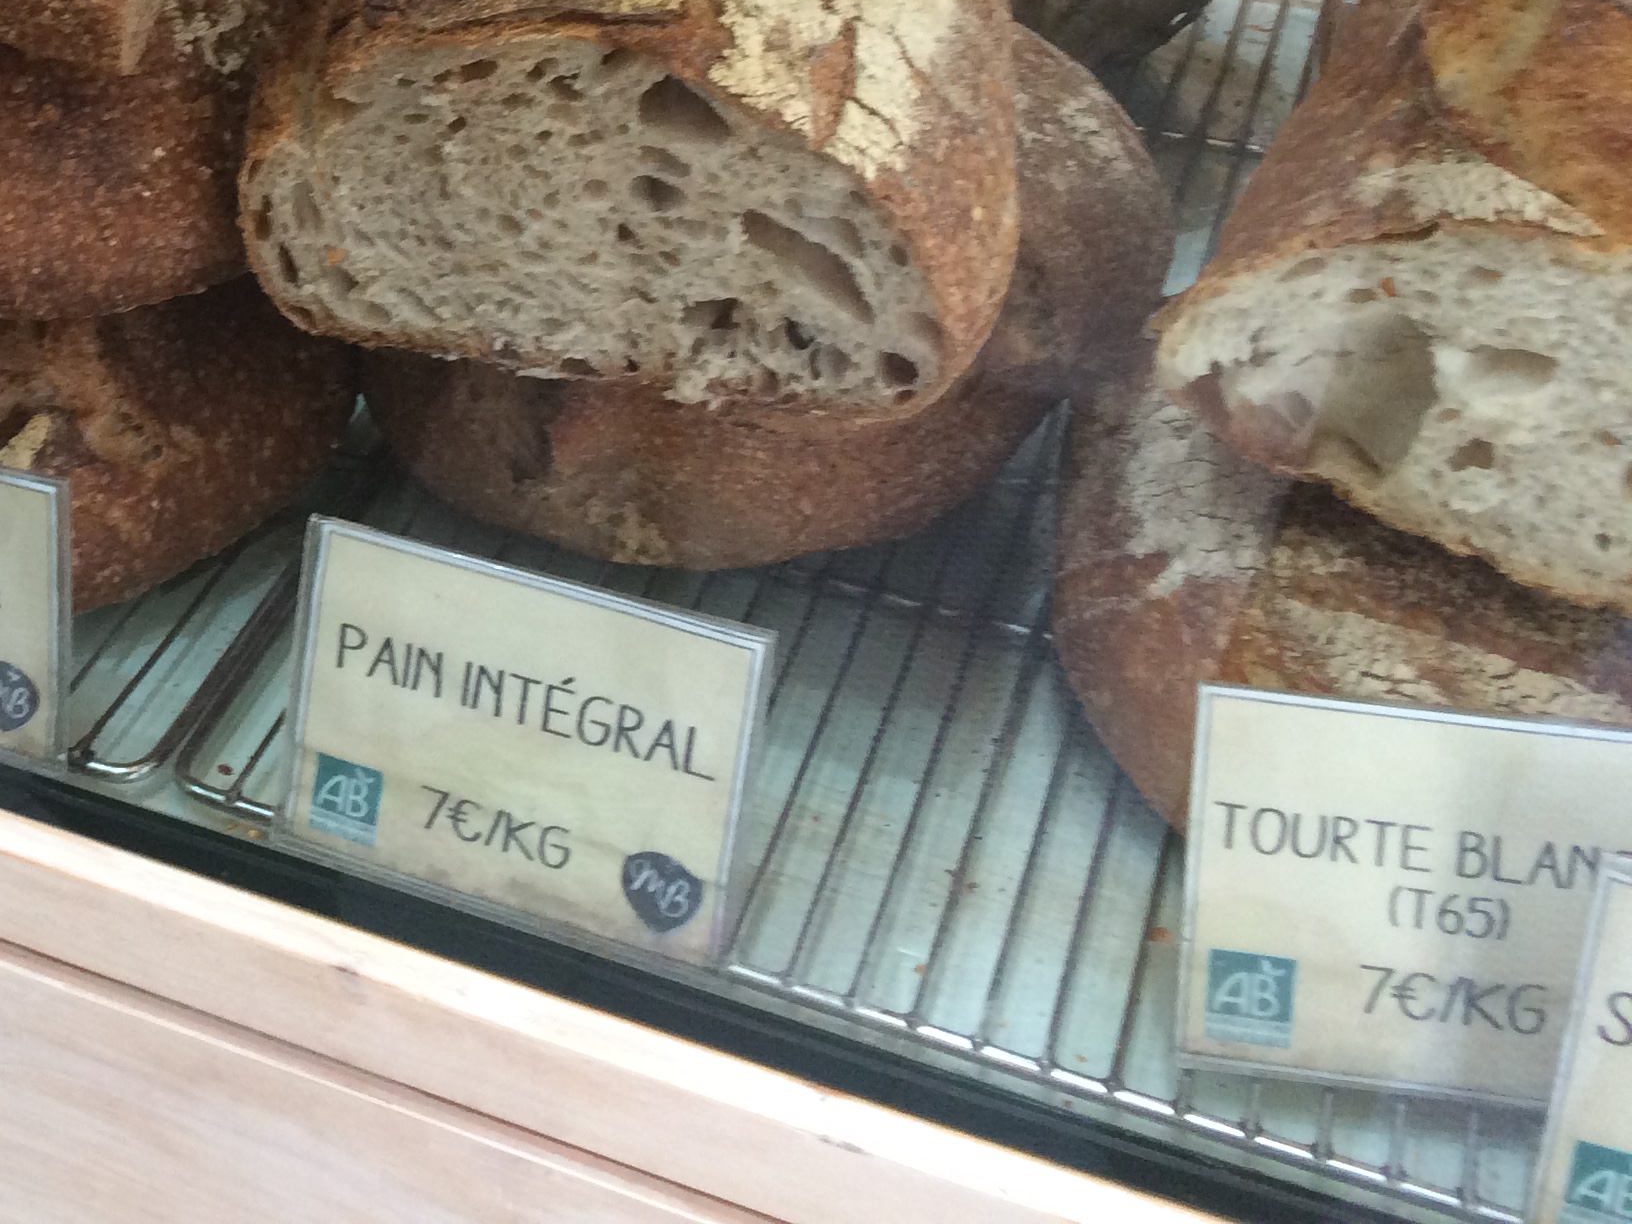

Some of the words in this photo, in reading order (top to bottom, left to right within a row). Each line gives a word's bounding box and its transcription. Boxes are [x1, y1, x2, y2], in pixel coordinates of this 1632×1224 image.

[334, 622, 444, 699] PAIN
[460, 659, 716, 782] INTÉGRAL
[420, 784, 572, 870] 7€/KG
[1213, 799, 1433, 874] TOURTE
[1455, 829, 1632, 890] BLAN
[1387, 884, 1512, 940] (T65)
[1359, 963, 1551, 1036] 7€/KG
